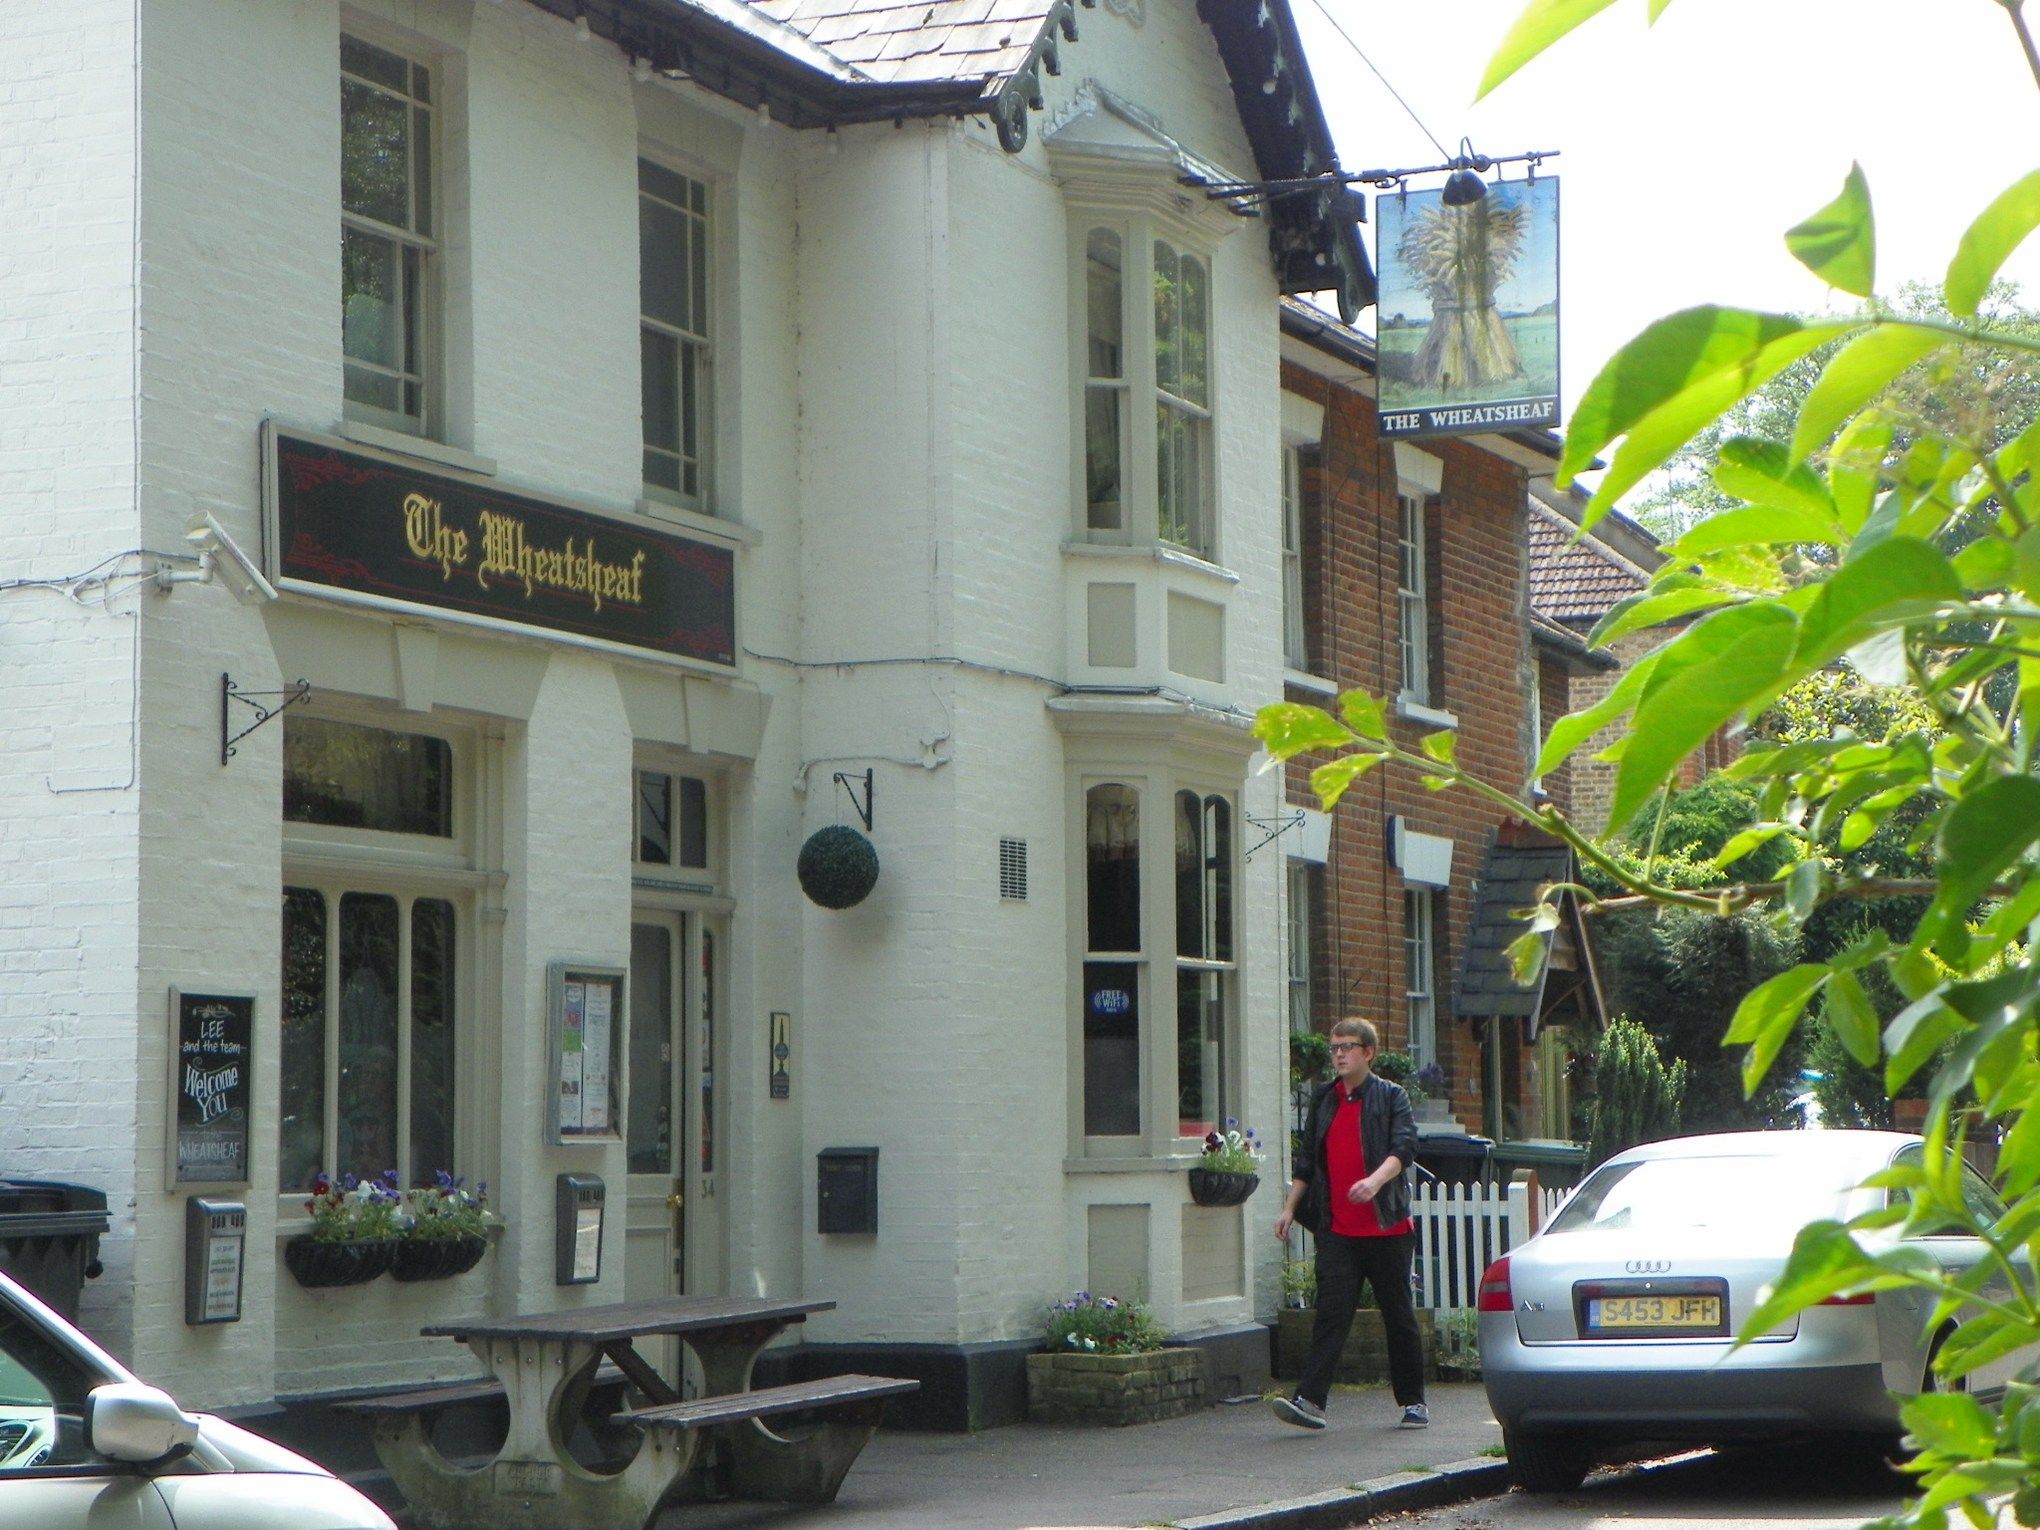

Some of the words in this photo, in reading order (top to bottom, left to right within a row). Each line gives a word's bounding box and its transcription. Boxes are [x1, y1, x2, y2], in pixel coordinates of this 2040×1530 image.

[1383, 413, 1420, 431] THE
[1429, 401, 1554, 427] WHEATSHEAF
[403, 492, 468, 581] The
[477, 510, 646, 612] Wheatsheaf
[1101, 989, 1122, 999] FREE
[201, 1020, 225, 1038] LEE
[182, 1041, 200, 1053] and
[202, 1041, 218, 1053] the
[221, 1039, 241, 1055] team
[184, 1063, 239, 1099] Welcome
[701, 1179, 715, 1199] 34
[1605, 1300, 1664, 1321] S453
[1671, 1299, 1716, 1321] JFH
